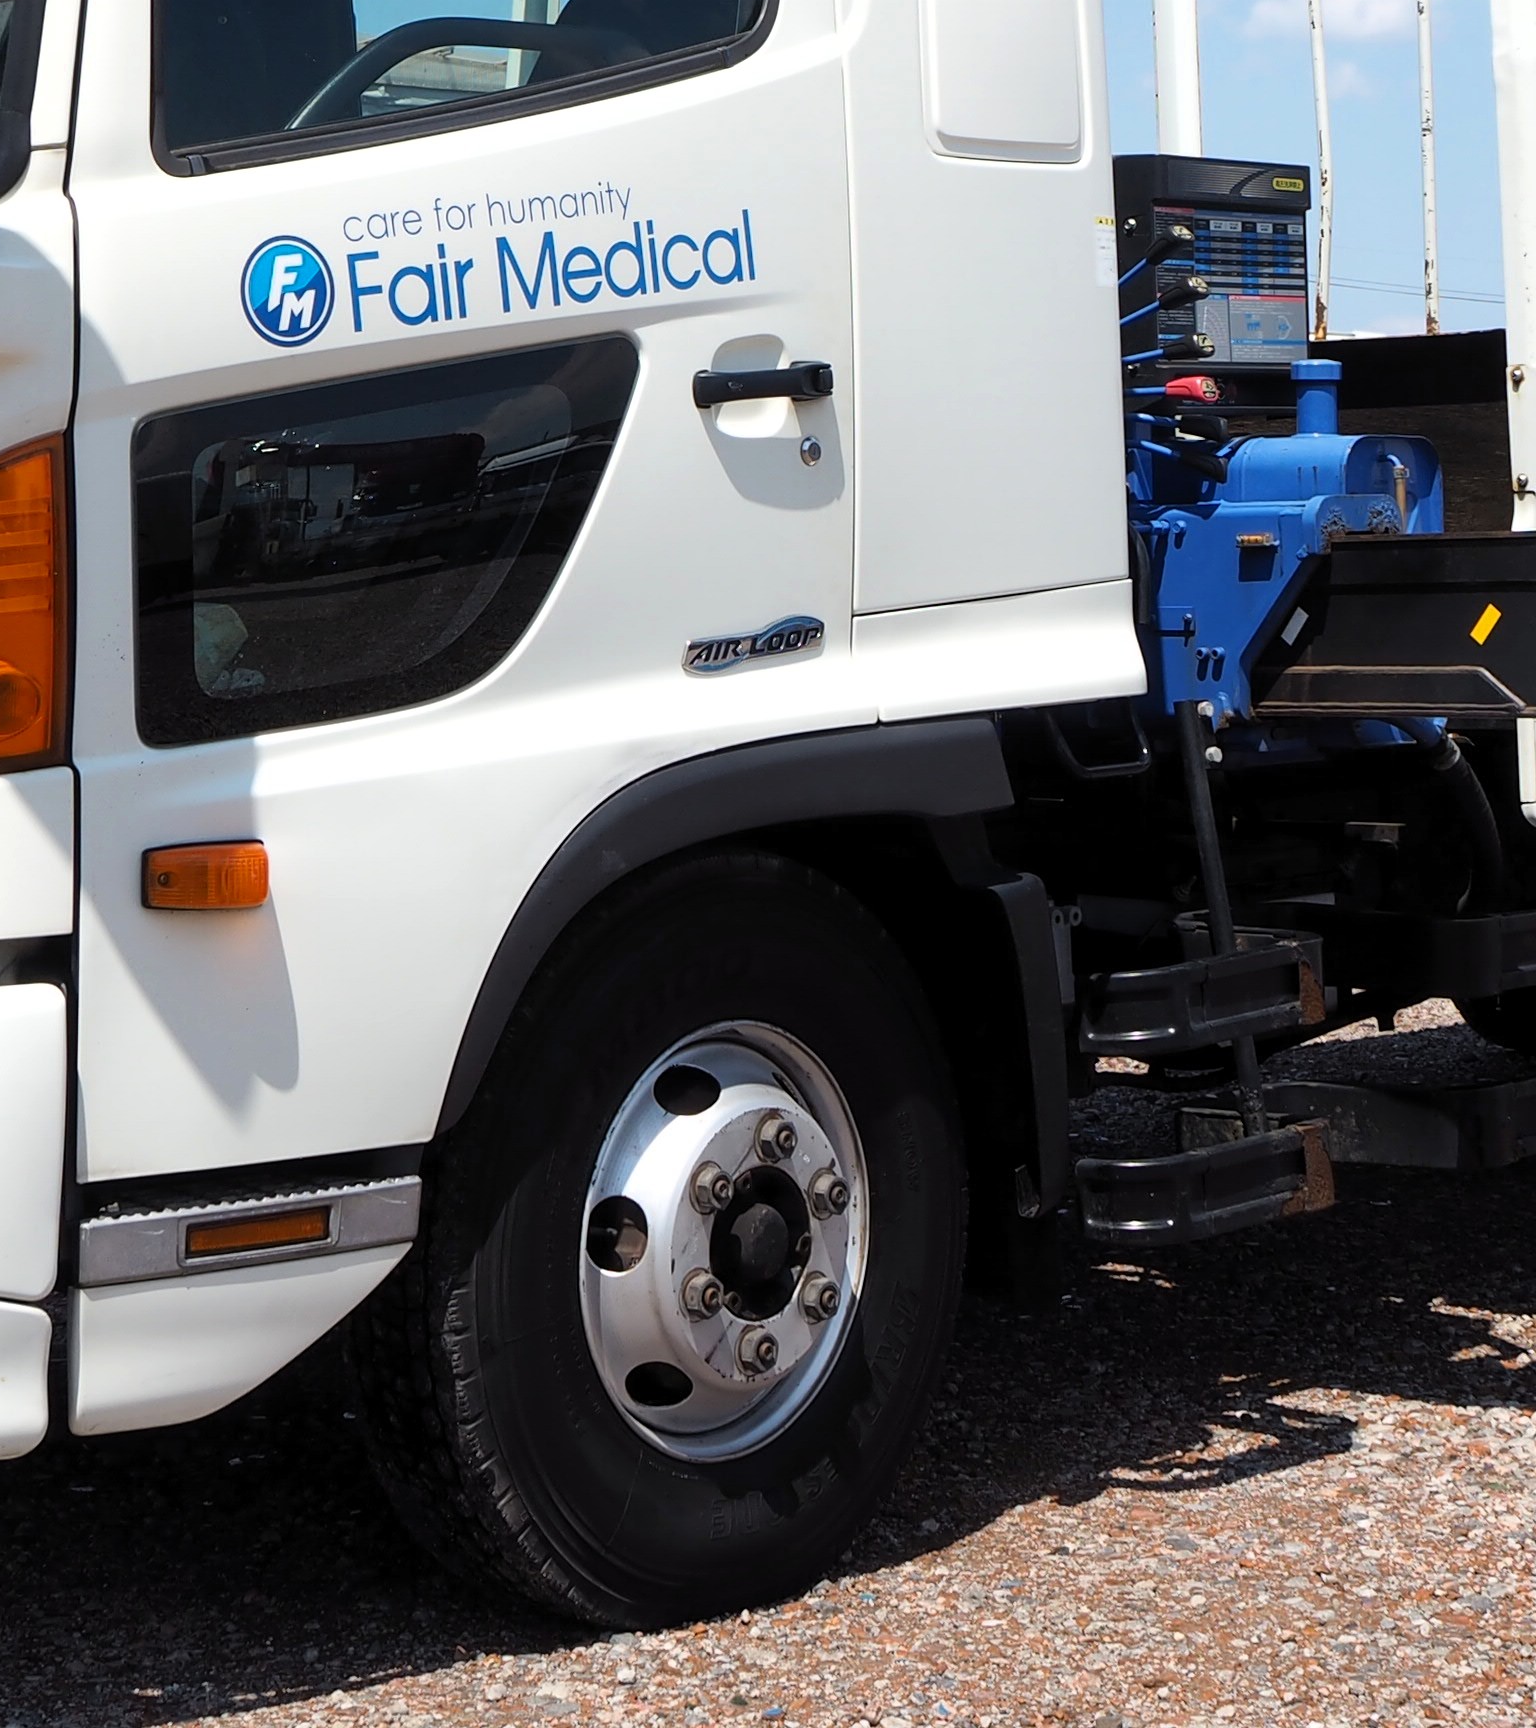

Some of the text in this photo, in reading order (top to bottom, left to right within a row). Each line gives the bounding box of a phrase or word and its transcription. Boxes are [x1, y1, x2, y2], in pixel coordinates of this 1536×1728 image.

[343, 181, 632, 243] care for humanity
[345, 208, 757, 333] Fair Medical
[689, 627, 820, 666] AIR LOOP
